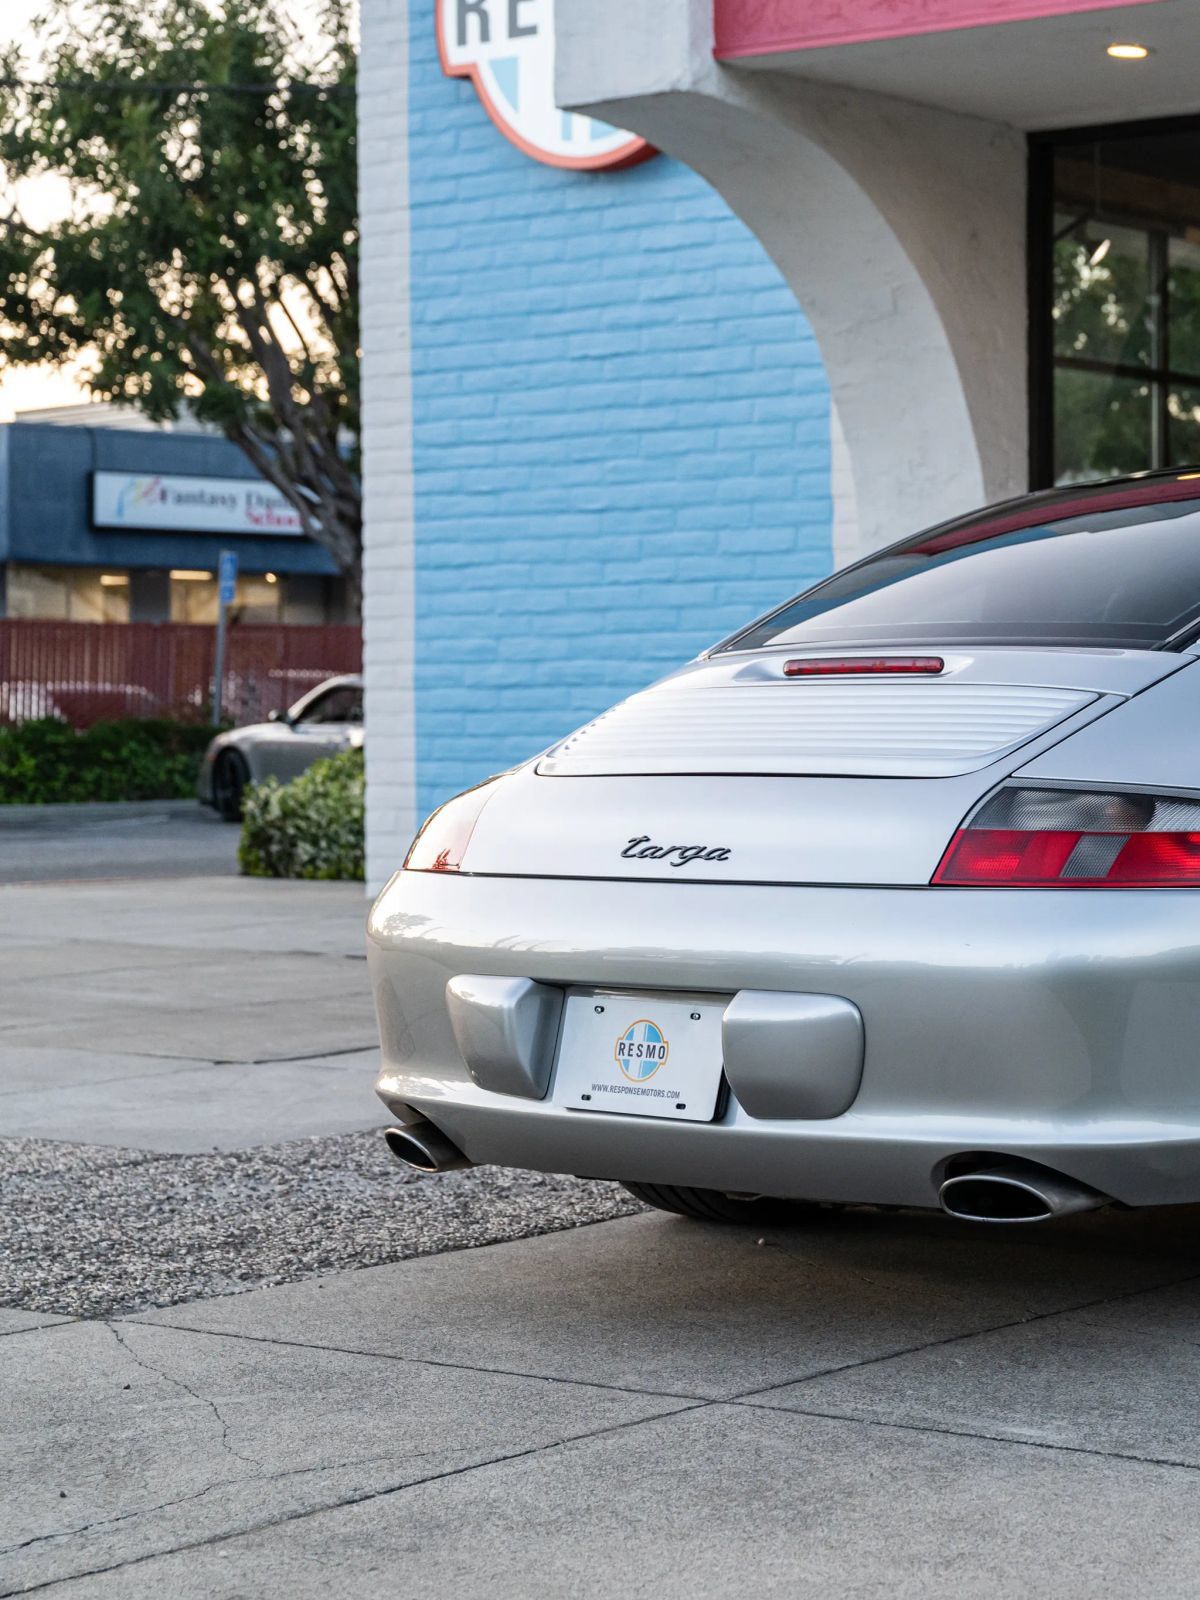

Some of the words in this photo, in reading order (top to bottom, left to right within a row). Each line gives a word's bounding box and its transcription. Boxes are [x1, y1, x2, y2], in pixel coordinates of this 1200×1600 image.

[620, 835, 732, 867] targa
[618, 1041, 666, 1060] RESMO
[591, 1083, 681, 1099] WWW.RESPONSEMOTORS.COM
